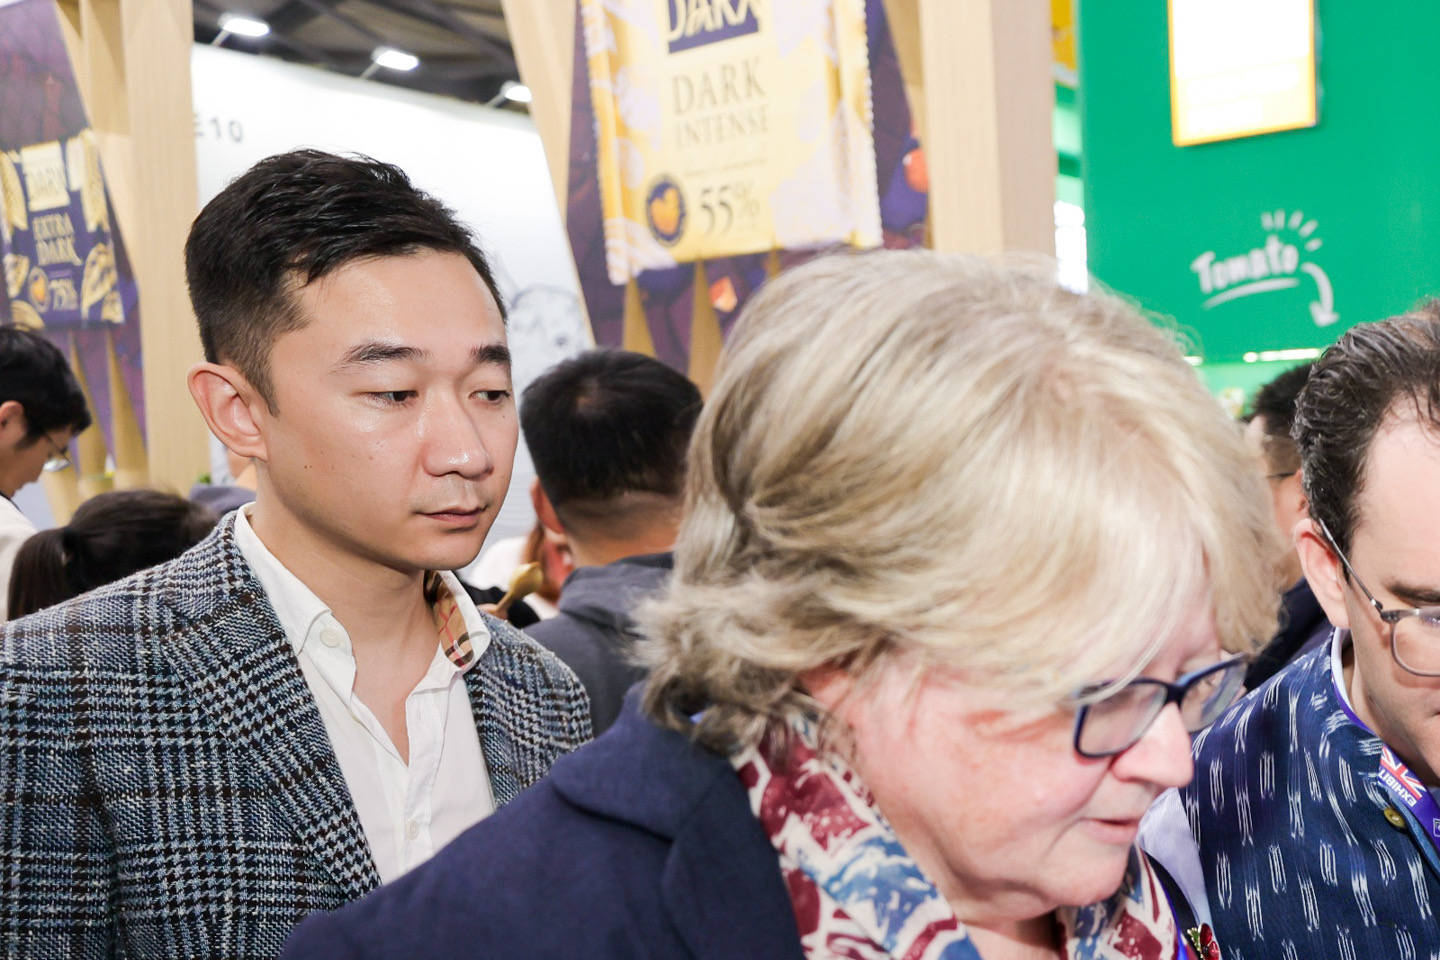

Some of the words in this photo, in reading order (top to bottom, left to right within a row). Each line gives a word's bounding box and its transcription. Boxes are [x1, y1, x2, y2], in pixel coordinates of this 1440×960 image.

[672, 57, 767, 116] DARK
[675, 103, 769, 150] INTENSE
[700, 180, 761, 238] 55%
[36, 236, 83, 267] DARK
